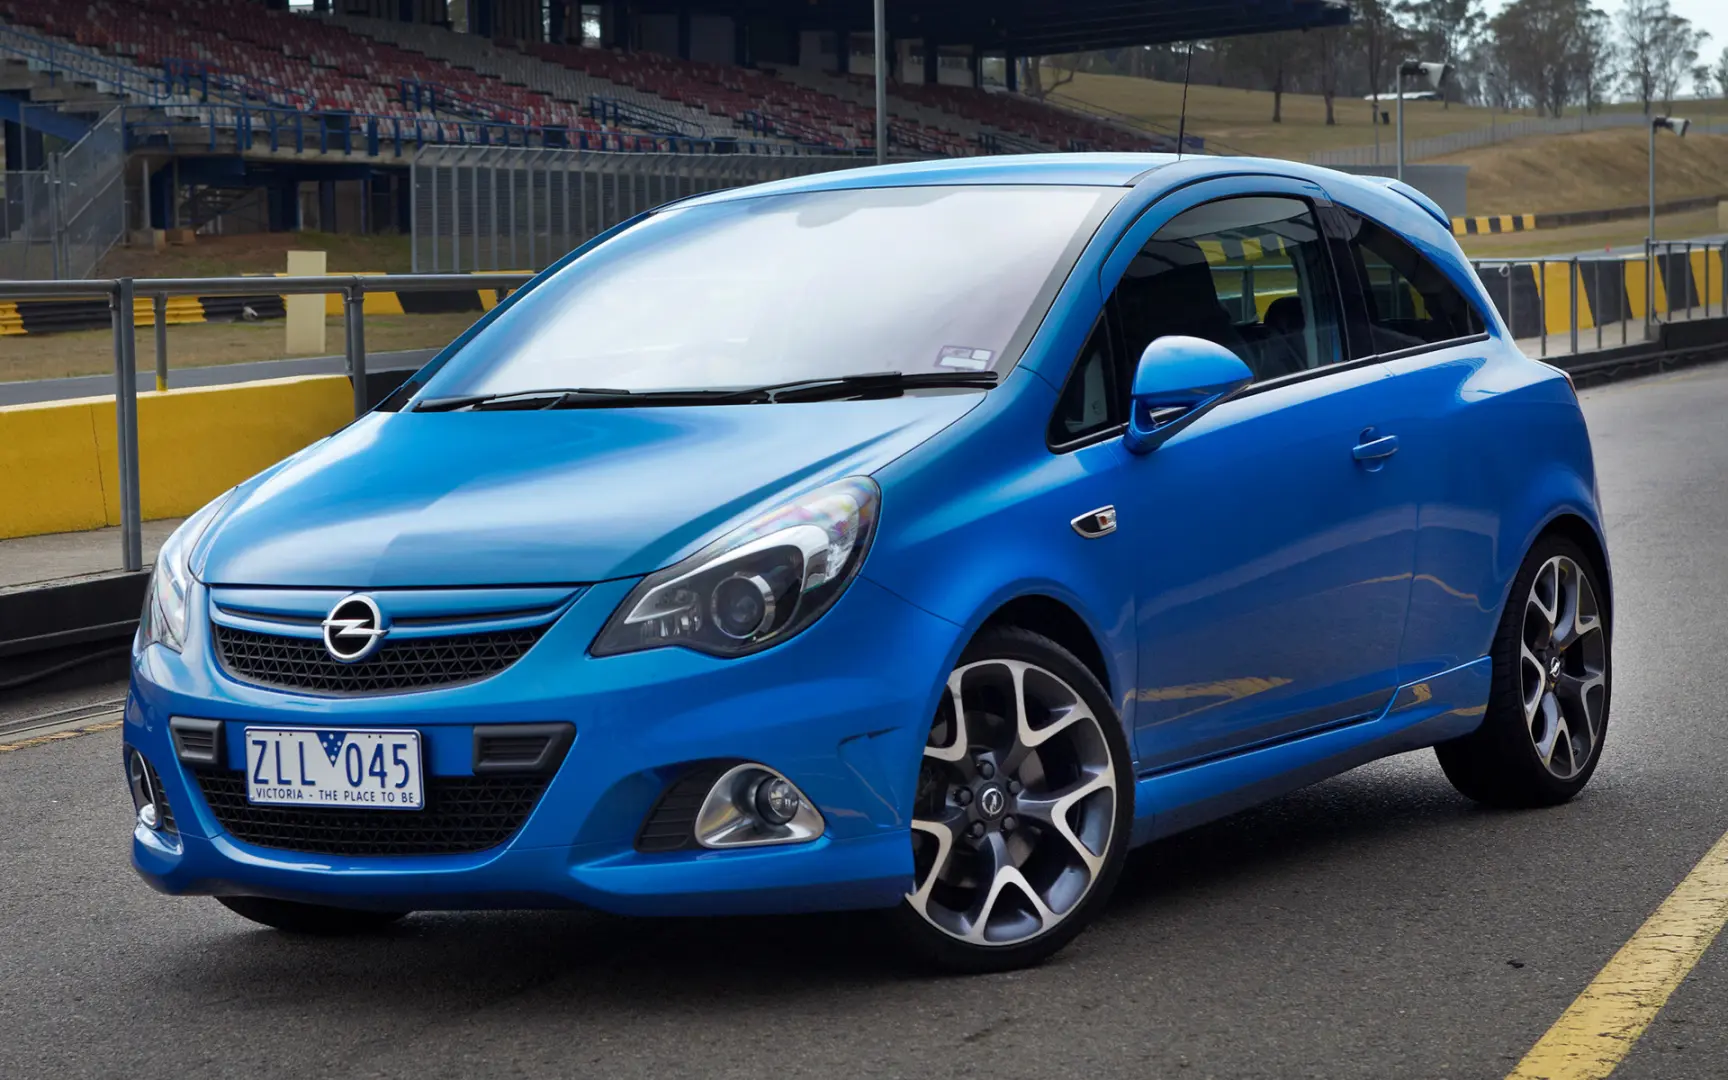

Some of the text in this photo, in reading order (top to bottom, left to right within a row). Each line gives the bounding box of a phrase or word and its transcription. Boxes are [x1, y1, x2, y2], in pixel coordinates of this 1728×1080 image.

[251, 739, 410, 789] ZLL 045
[255, 787, 304, 800] VICTORIA
[318, 789, 338, 801] THE
[343, 790, 375, 802] PLACE
[380, 791, 395, 803] TO
[401, 791, 414, 803] BE
